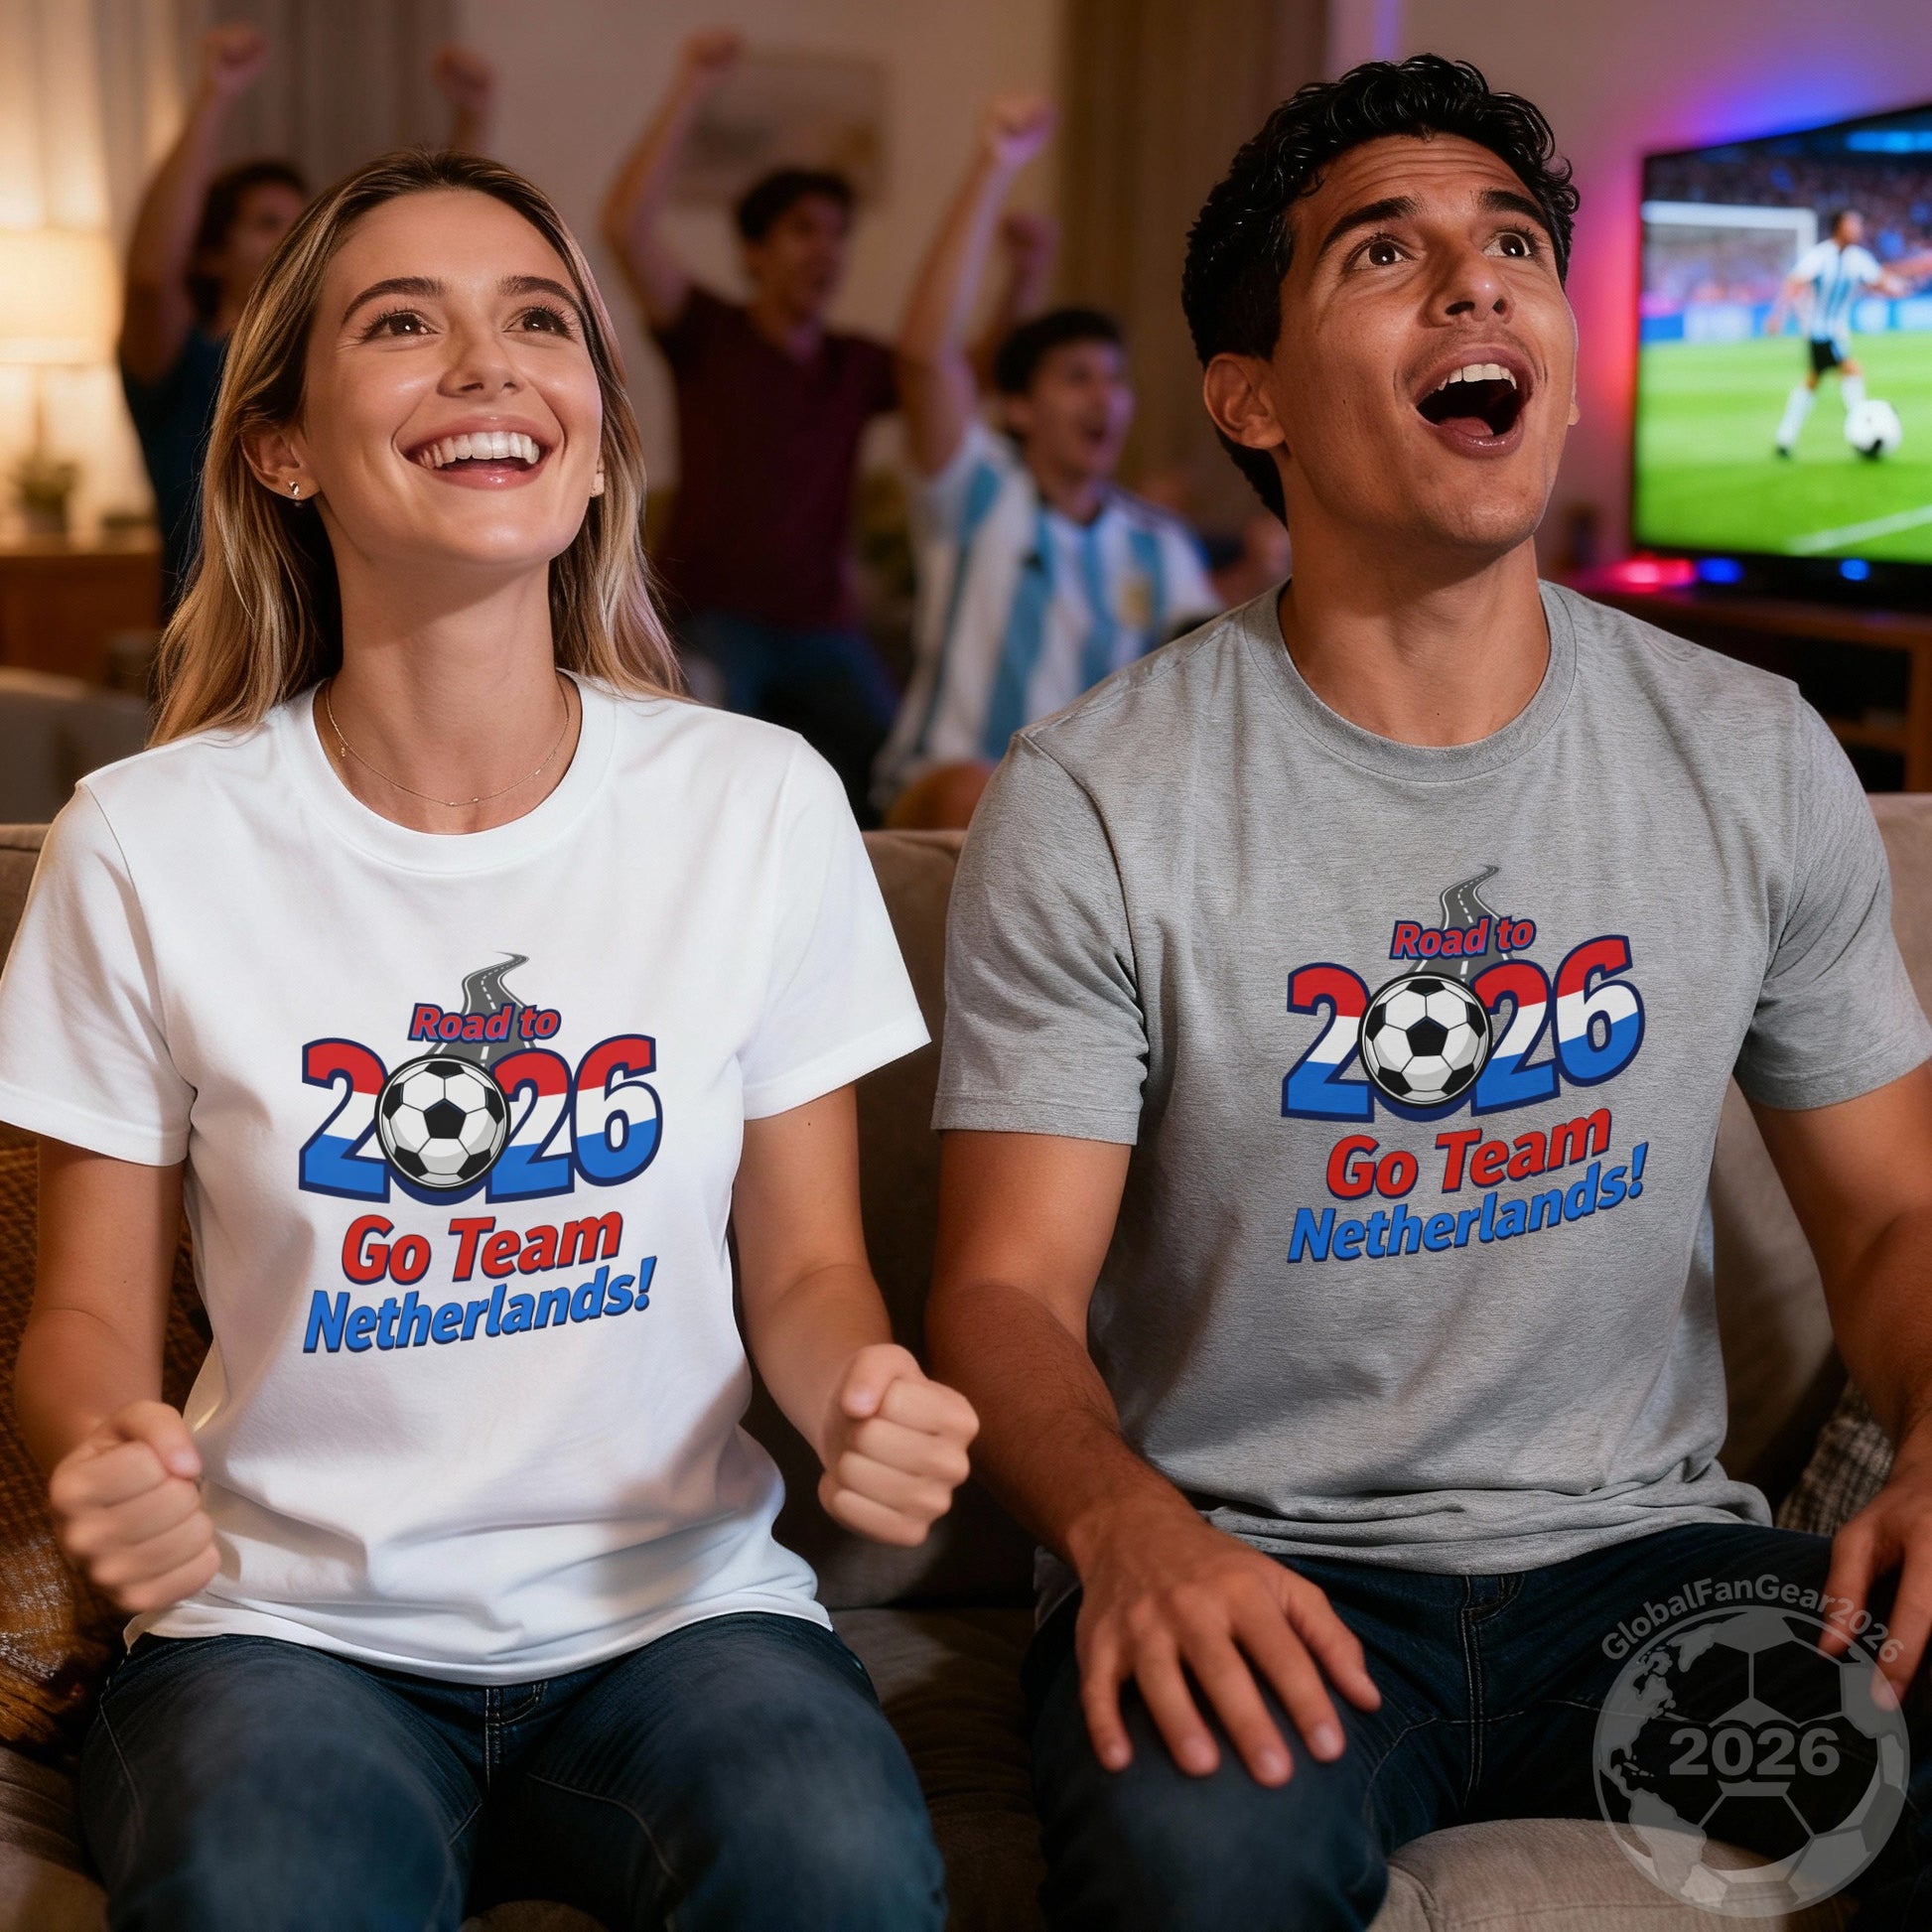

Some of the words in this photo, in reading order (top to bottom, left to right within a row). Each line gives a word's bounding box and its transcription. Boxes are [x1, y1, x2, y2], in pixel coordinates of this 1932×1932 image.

[1390, 915, 1492, 960] Road
[1494, 916, 1537, 955] to
[407, 1003, 516, 1043] Road
[517, 1004, 562, 1040] to
[1325, 1134, 1419, 1200] Go
[1435, 1108, 1612, 1193] Team
[1287, 1141, 1649, 1263] Netherlands!
[342, 1214, 432, 1286] Go
[448, 1210, 623, 1283] Team
[303, 1255, 657, 1353] Netherlands!
